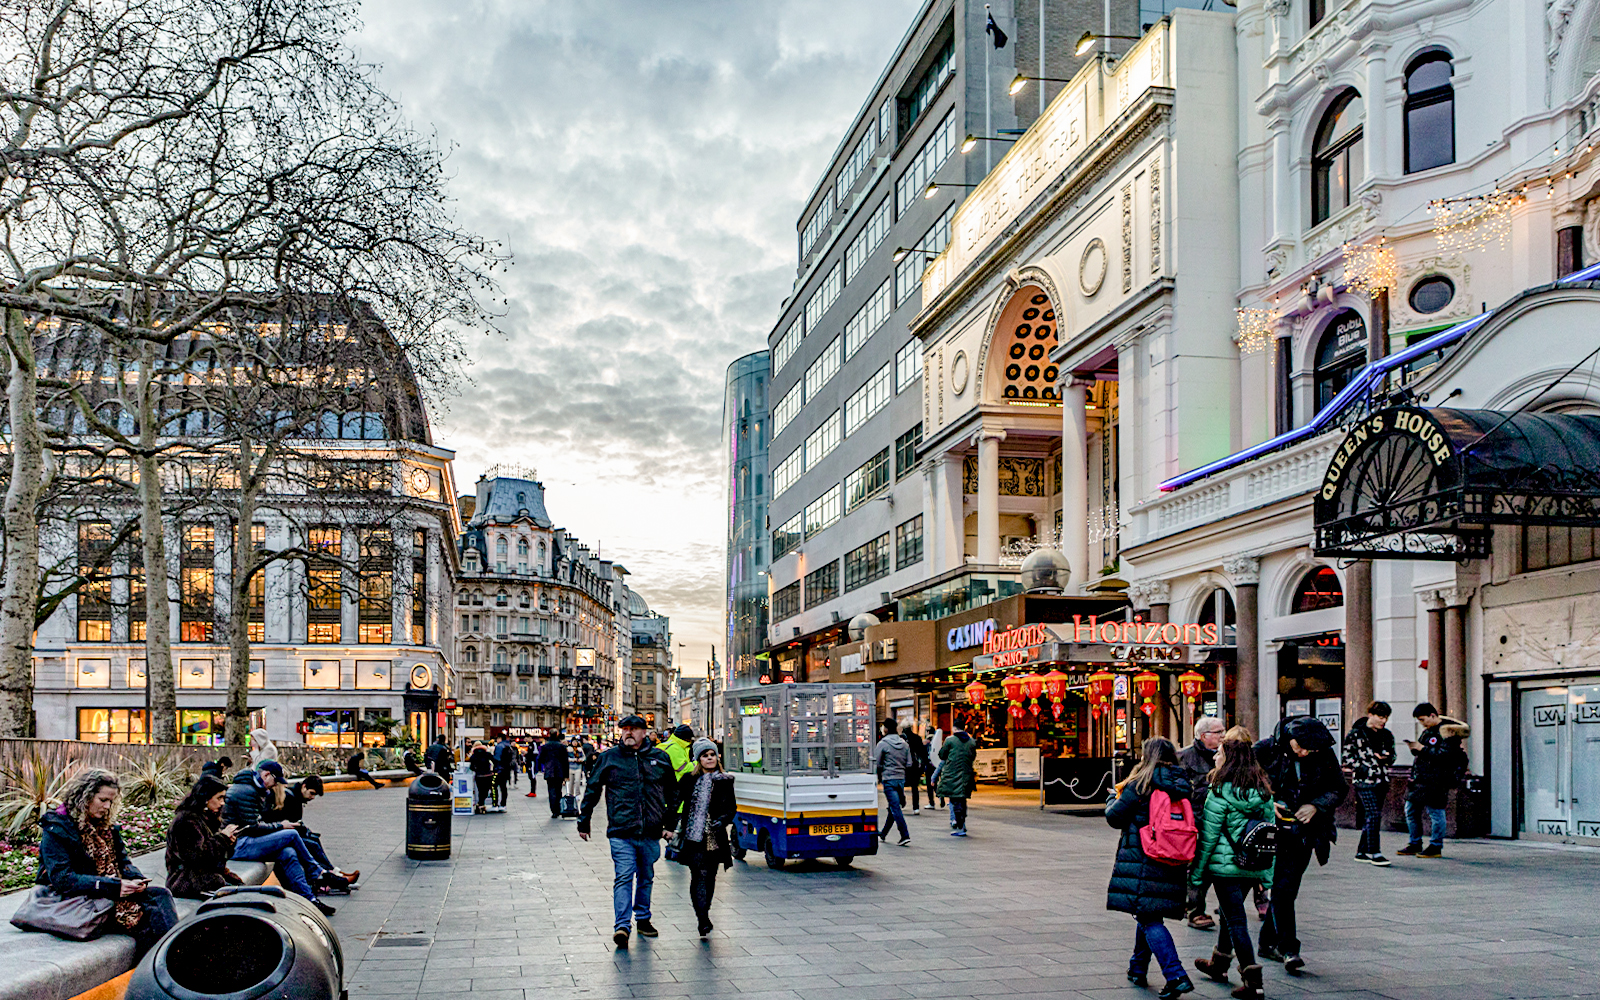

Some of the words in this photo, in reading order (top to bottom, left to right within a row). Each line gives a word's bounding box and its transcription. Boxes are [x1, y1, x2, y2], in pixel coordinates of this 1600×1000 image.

[967, 191, 1009, 252] EMPIRE
[1015, 117, 1080, 200] THEATRE
[1337, 317, 1362, 336] Ruby
[1338, 330, 1360, 347] Blue
[1323, 415, 1384, 500] QUEEN'S
[1394, 411, 1450, 466] HOUSE
[947, 617, 996, 652] CASINO
[983, 622, 1046, 655] Horizons
[1072, 614, 1219, 645] Horizons
[992, 651, 1023, 669] CASINO
[1110, 645, 1183, 661] CASINO
[1538, 709, 1561, 723] LXA
